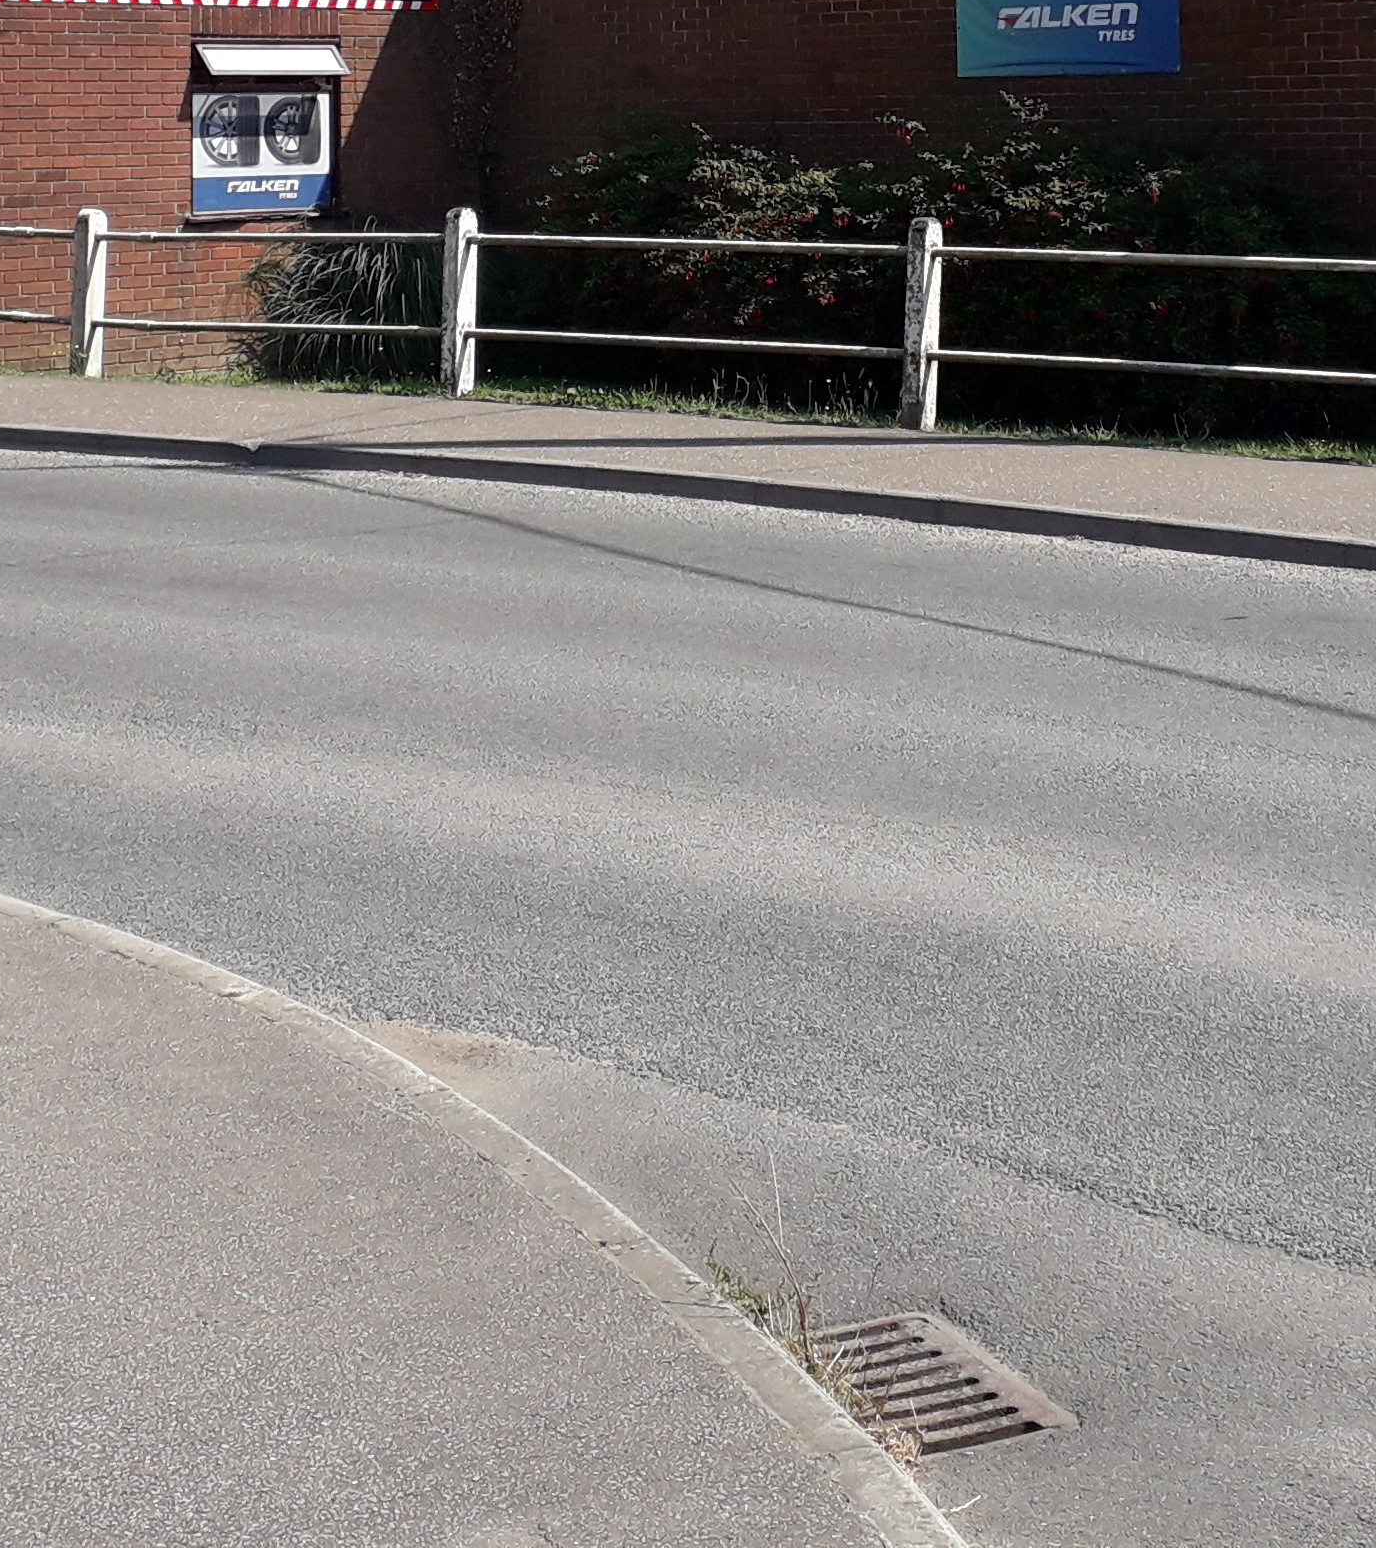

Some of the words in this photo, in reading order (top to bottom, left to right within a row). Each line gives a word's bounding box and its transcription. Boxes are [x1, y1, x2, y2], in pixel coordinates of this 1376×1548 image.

[997, 2, 1139, 30] FALKEN
[1097, 29, 1136, 42] TYRES
[227, 179, 300, 193] FALKEN
